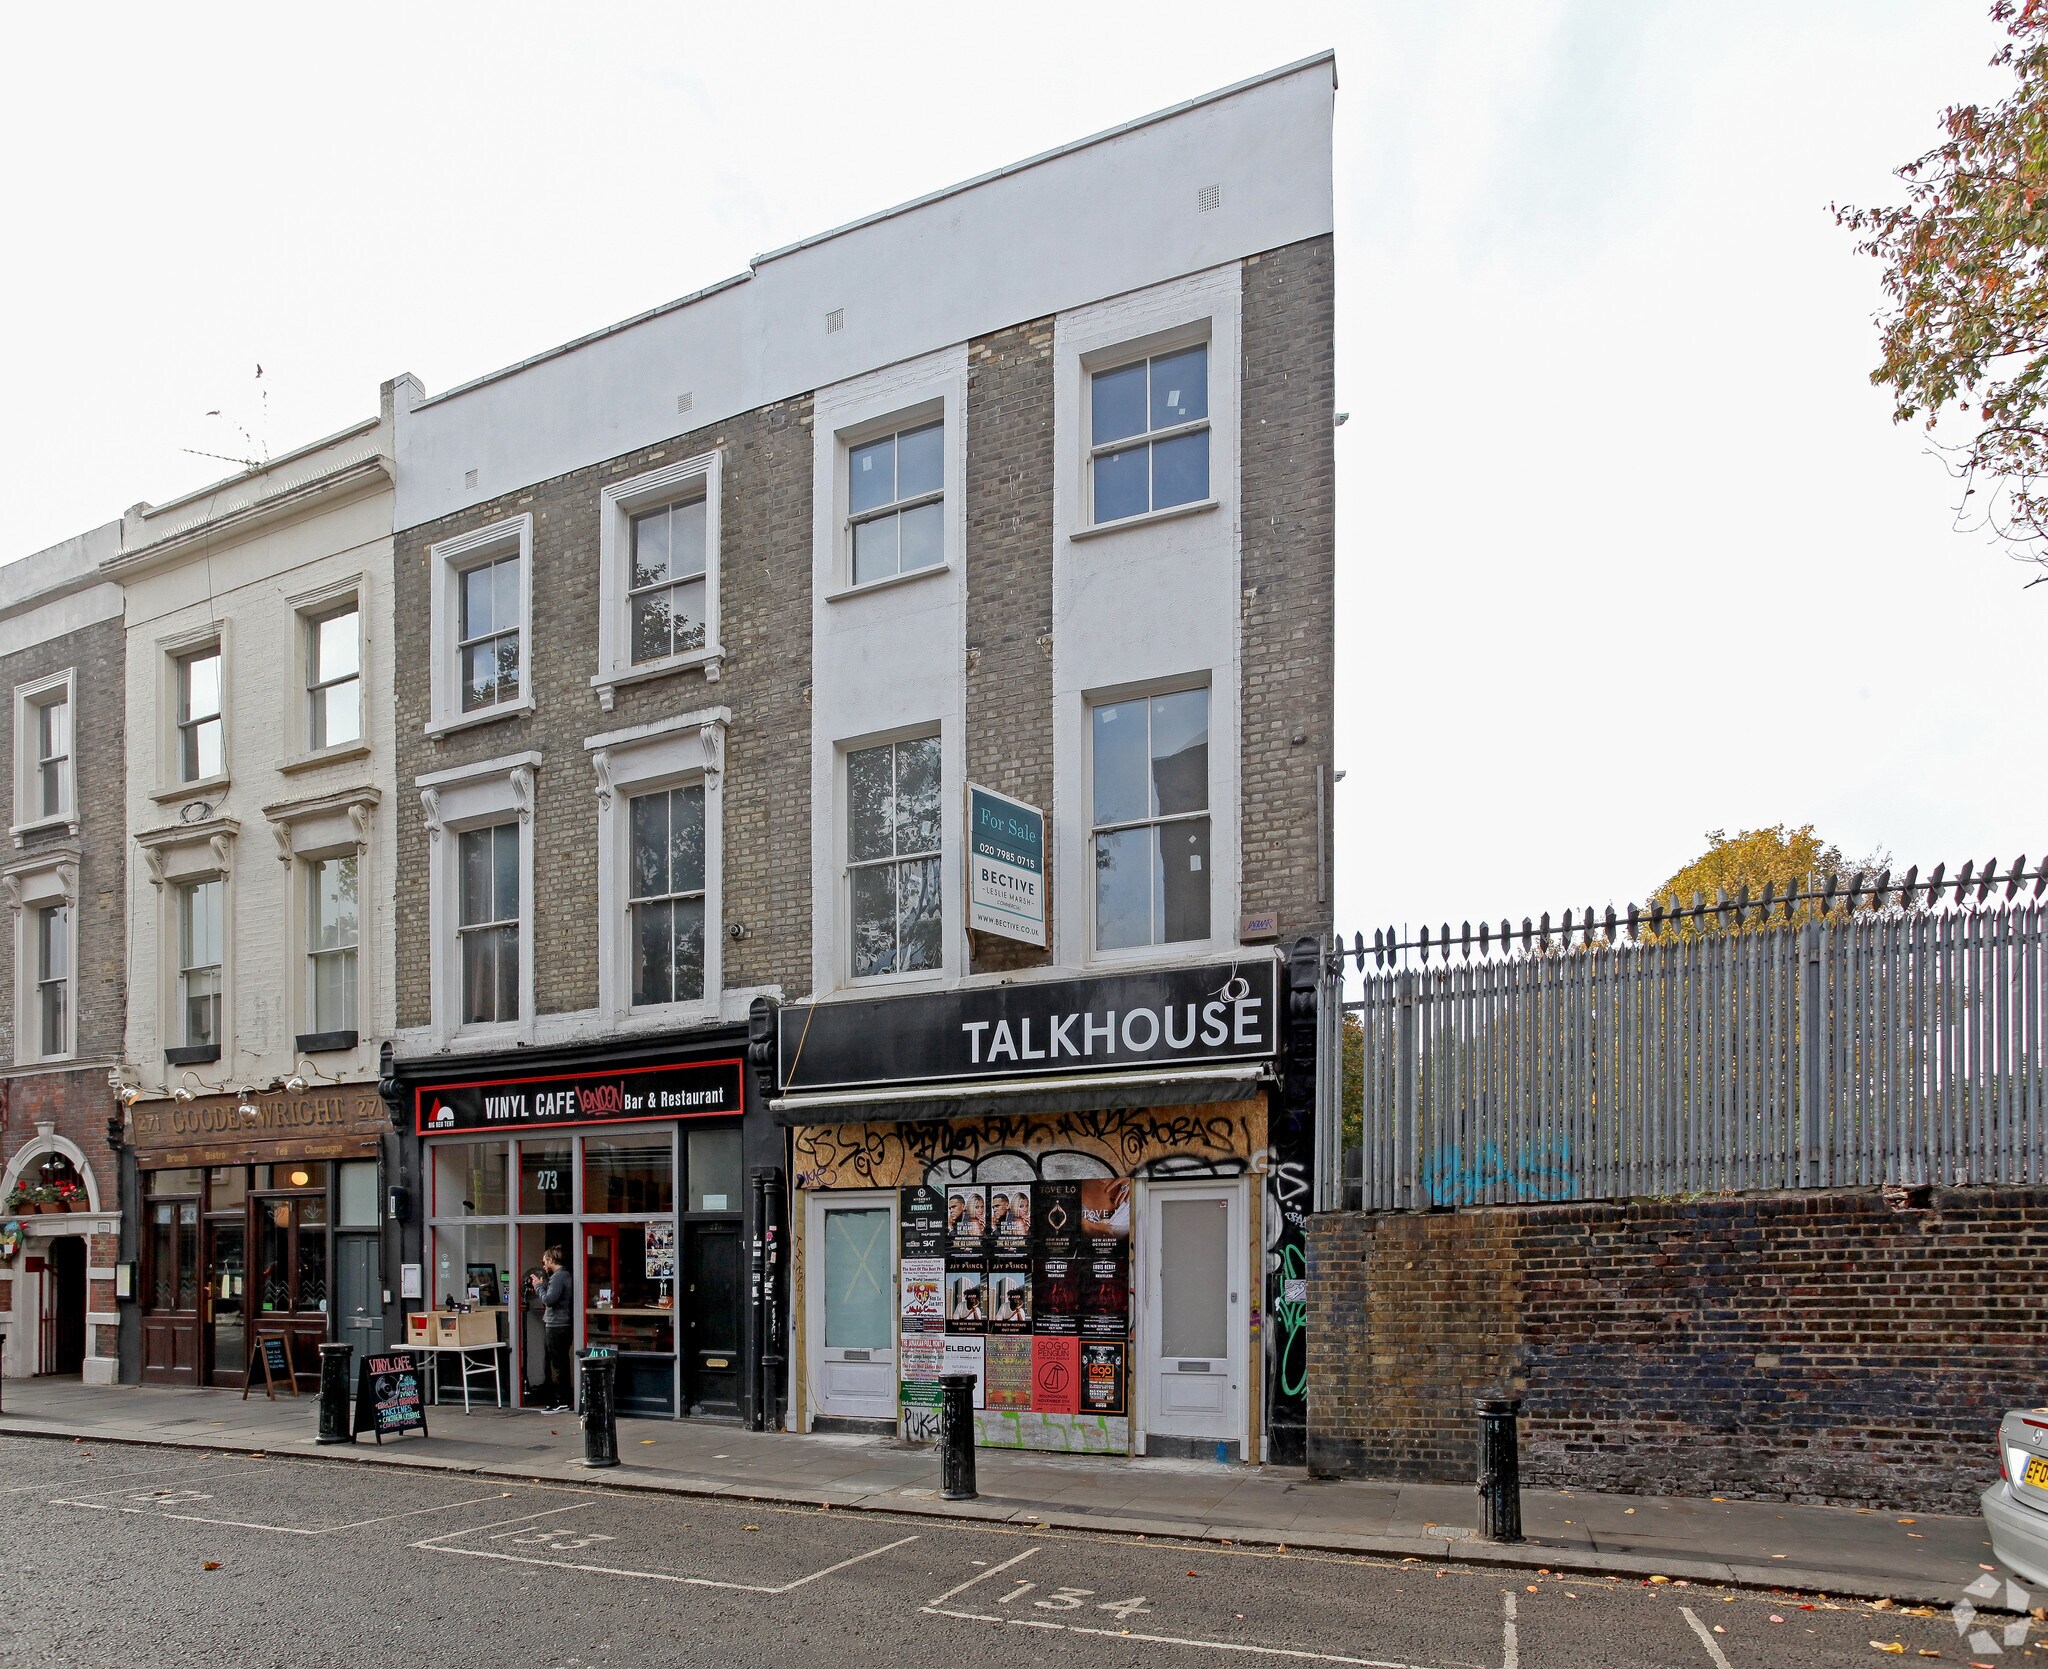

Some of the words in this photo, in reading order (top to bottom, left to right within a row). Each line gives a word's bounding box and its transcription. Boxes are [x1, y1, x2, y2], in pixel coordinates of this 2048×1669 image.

[981, 807, 1004, 831] For
[1009, 818, 1036, 843] Sale
[979, 843, 995, 856] 020
[996, 848, 1015, 862] 7985
[1017, 856, 1035, 869] 0715
[981, 868, 1035, 896] BECTIVE
[986, 887, 1008, 900] LESLIE
[1009, 892, 1031, 906] MARSH
[962, 998, 1262, 1064] TALKHOUSE
[485, 1095, 530, 1119] VINYL
[535, 1091, 575, 1117] CAFE
[575, 1081, 625, 1116] LONDON
[624, 1094, 643, 1110] Bar
[648, 1092, 656, 1108] &
[661, 1087, 724, 1108] Restaurant
[139, 1114, 161, 1131] 271
[173, 1107, 240, 1135] GOODE
[259, 1096, 344, 1129] WRIGHT
[357, 1099, 384, 1118] 271
[205, 1151, 226, 1161] Bistro
[304, 1143, 344, 1155] Champagne
[537, 1171, 558, 1190] 273
[911, 1204, 933, 1212] FRIDAYS
[1082, 1209, 1109, 1219] TOVE
[945, 1345, 981, 1353] ELBOW
[1037, 1341, 1070, 1351] GOGO
[369, 1358, 394, 1373] VINYL
[394, 1355, 412, 1370] CAFE
[489, 1526, 617, 1549] 133
[1000, 1583, 1152, 1619] 134
